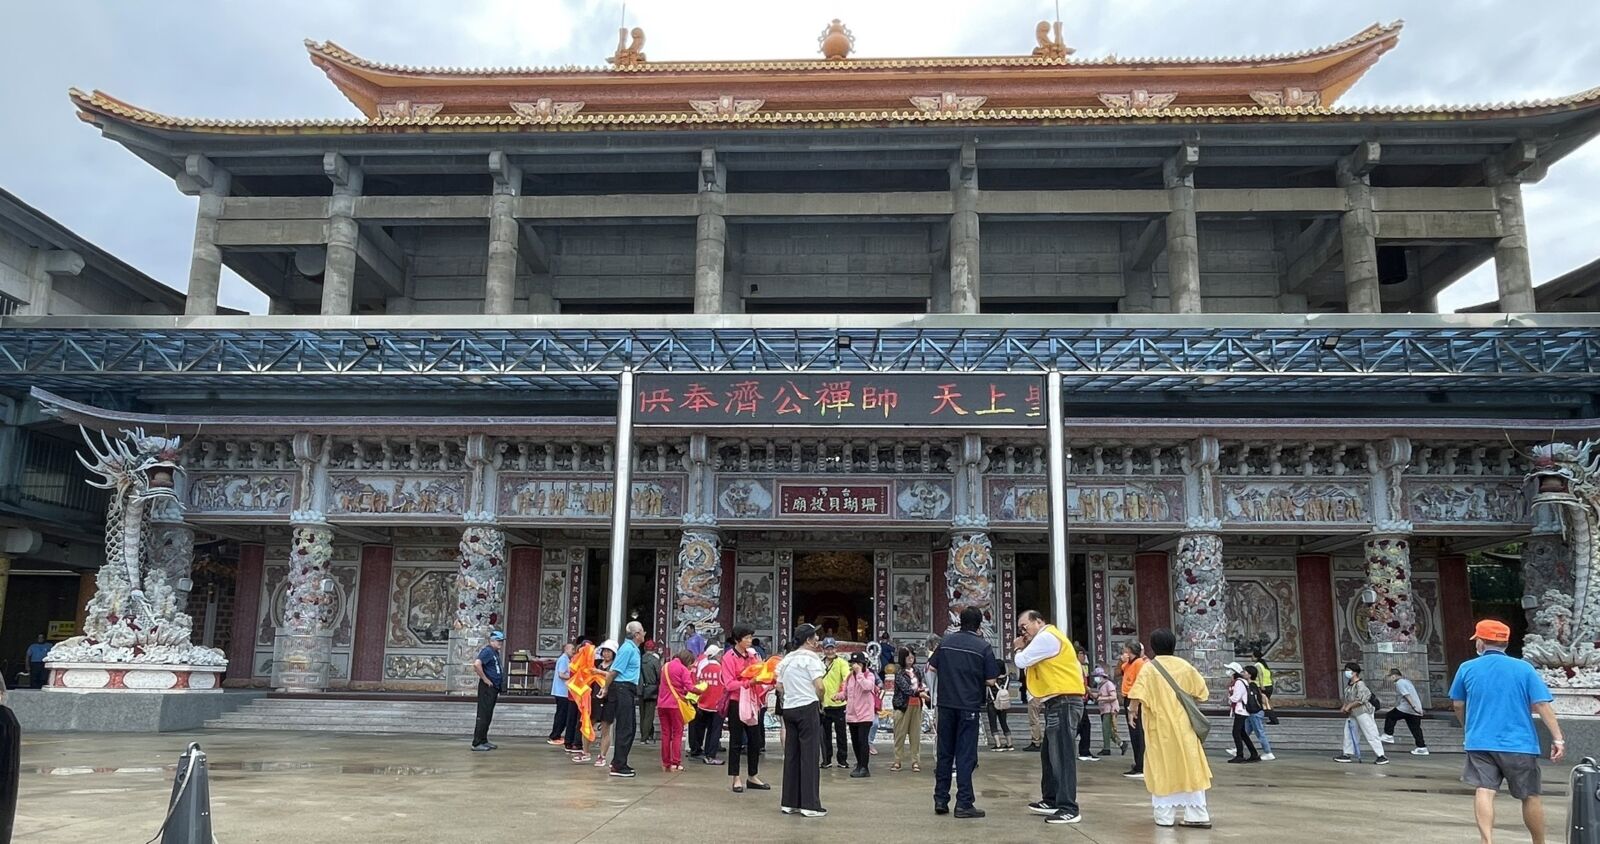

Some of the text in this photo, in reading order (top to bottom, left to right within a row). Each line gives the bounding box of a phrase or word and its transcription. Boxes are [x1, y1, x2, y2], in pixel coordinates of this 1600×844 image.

[792, 497, 877, 513] 珊瑚貝殼廟
